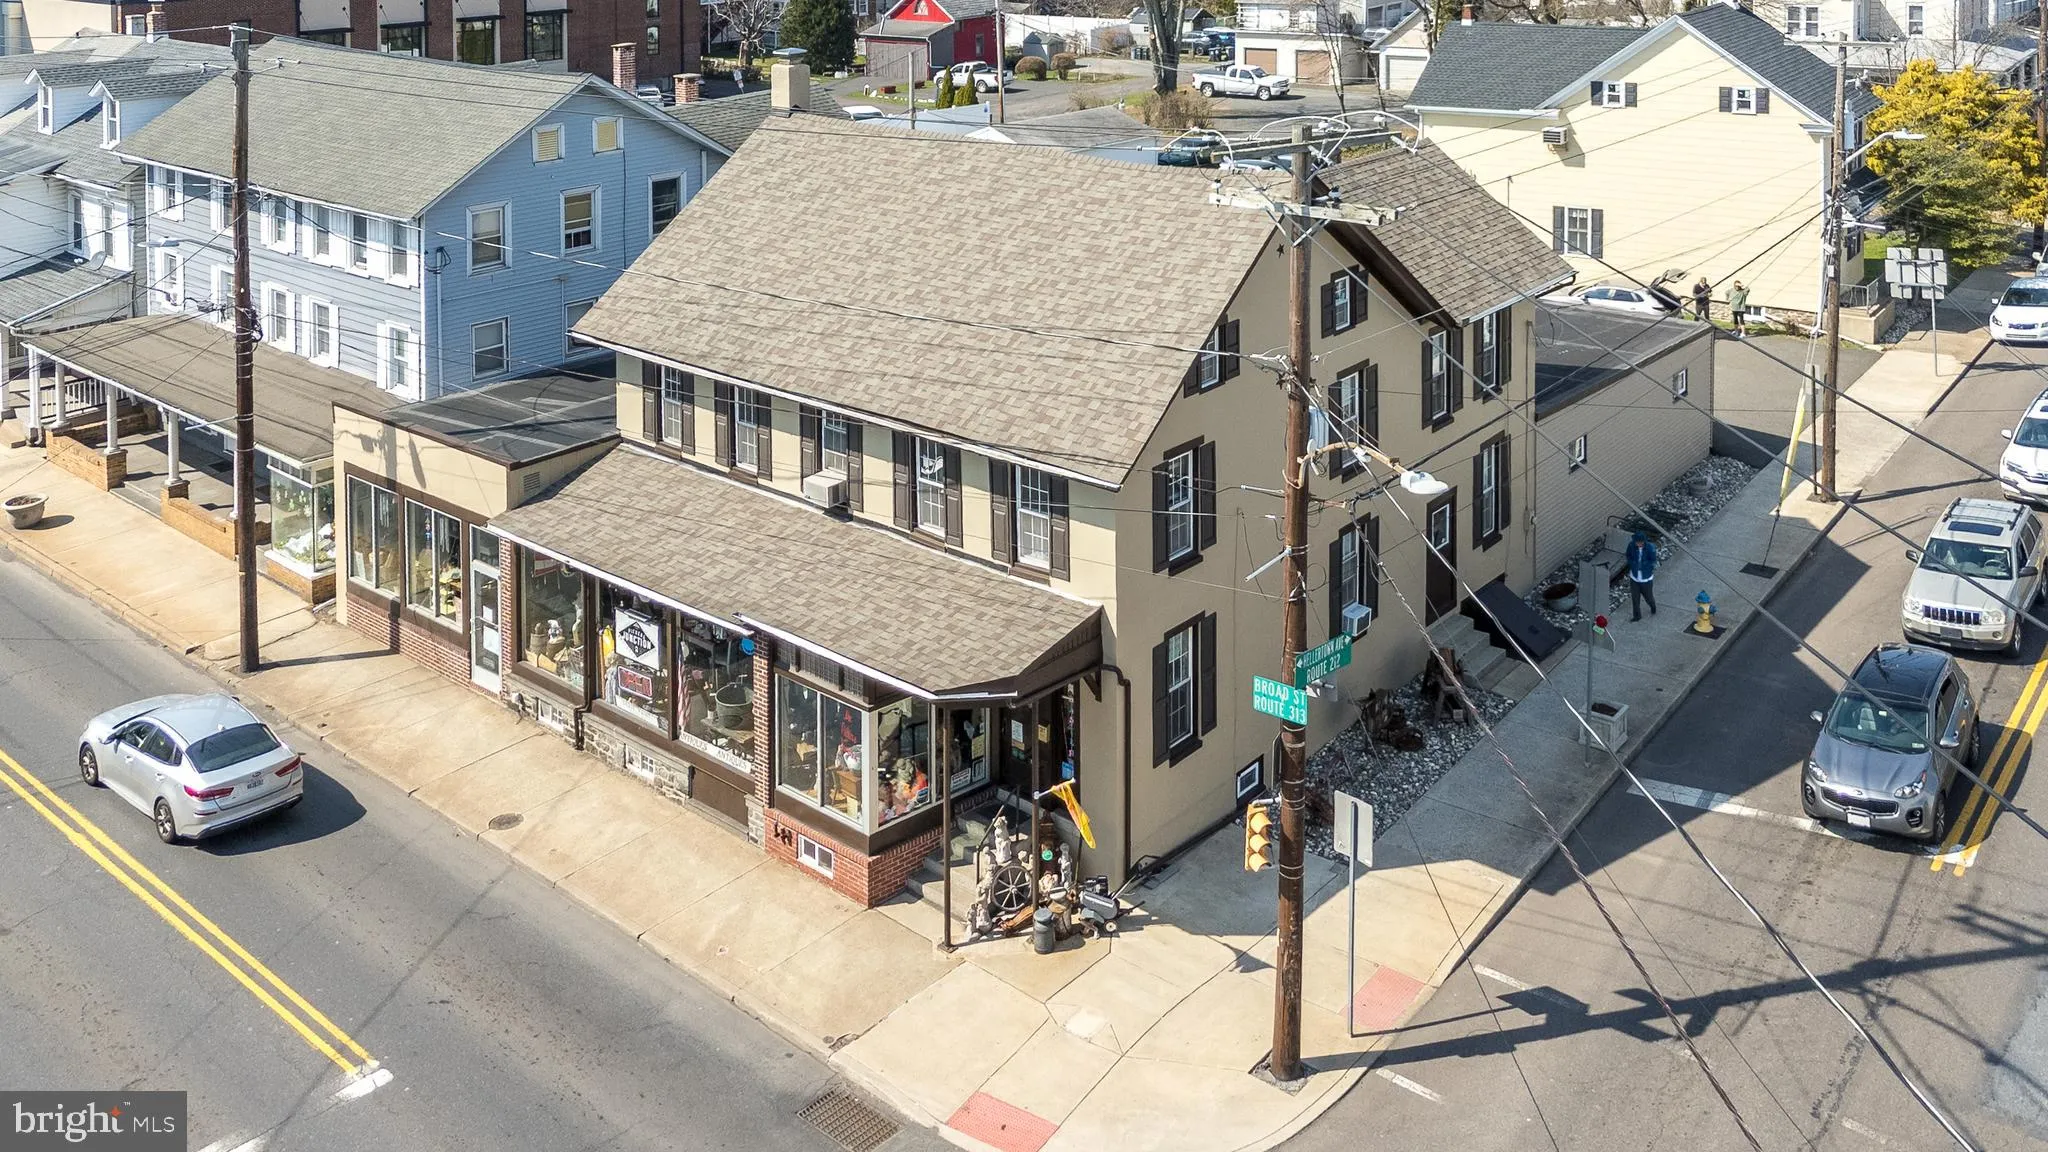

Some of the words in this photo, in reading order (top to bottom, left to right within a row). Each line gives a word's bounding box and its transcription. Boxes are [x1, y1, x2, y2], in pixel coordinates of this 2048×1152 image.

[621, 631, 652, 650] JUNCTION
[1335, 635, 1344, 651] AVE
[1306, 660, 1328, 683] ROUTE
[1330, 653, 1341, 672] 212
[1253, 679, 1289, 701] BROAD
[1293, 690, 1307, 706] ST
[1253, 695, 1285, 717] ROUTE
[1289, 705, 1307, 723] 313
